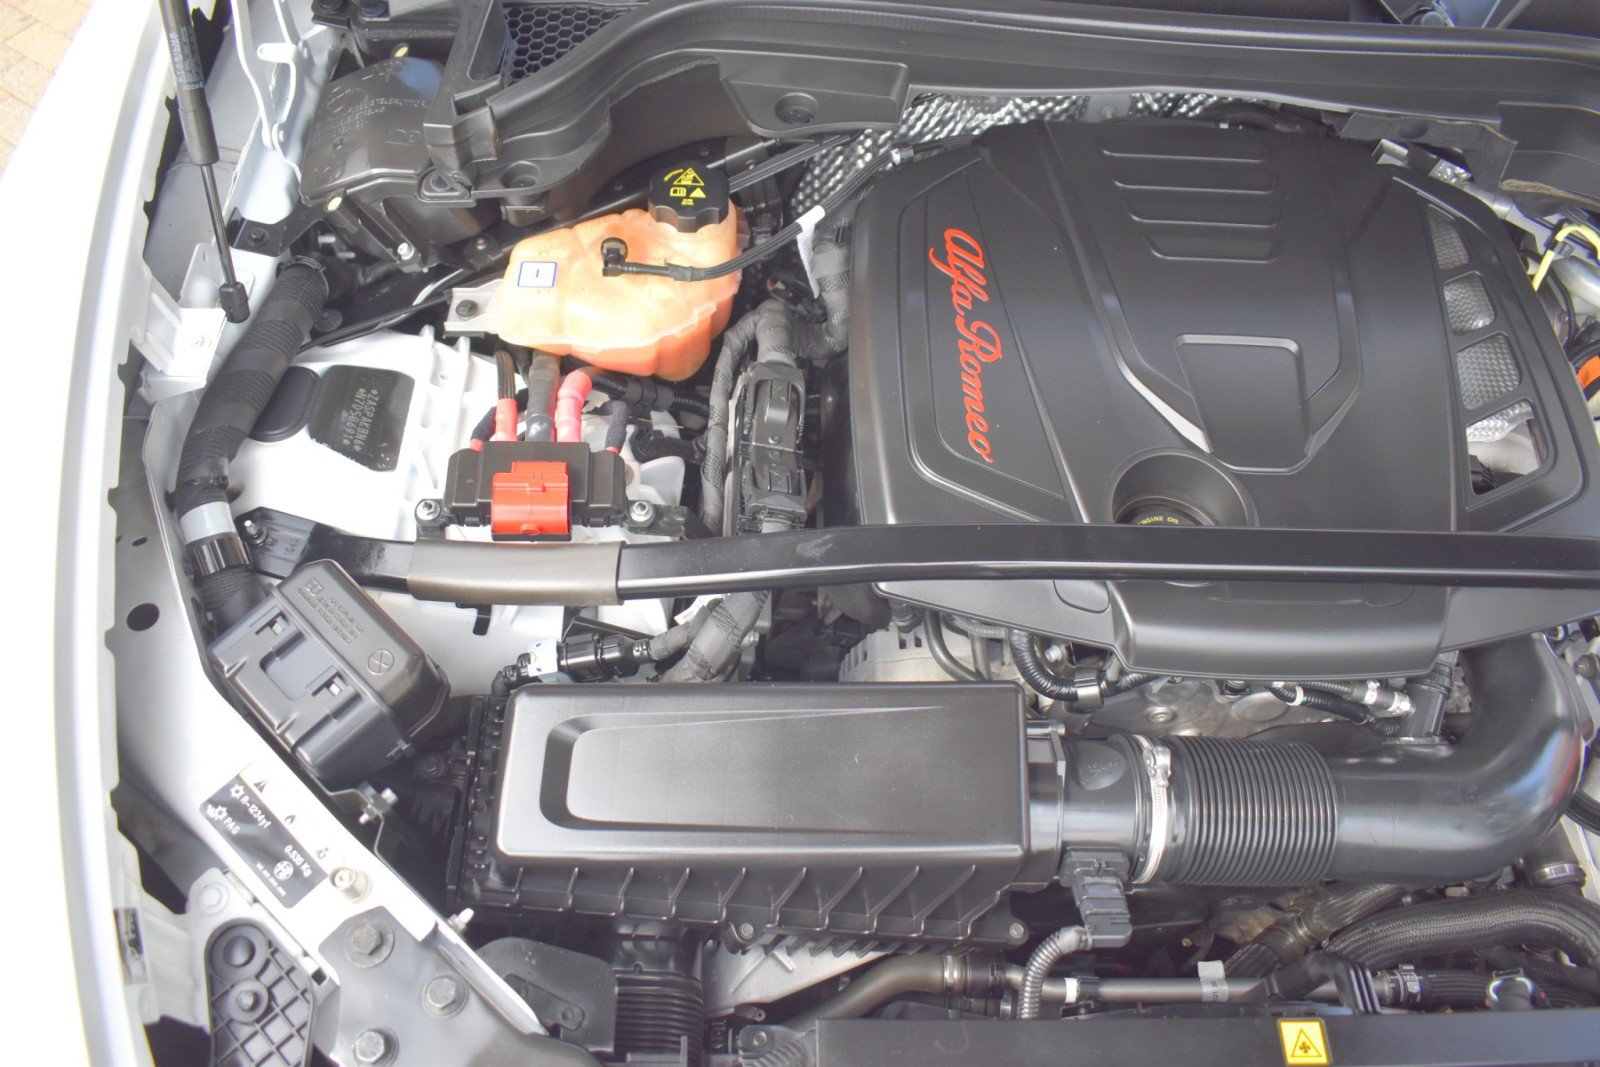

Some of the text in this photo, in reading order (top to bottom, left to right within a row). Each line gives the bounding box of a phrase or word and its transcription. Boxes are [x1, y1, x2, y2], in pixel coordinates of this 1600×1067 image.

[929, 228, 1002, 463] Alfa Romeo
[1138, 516, 1180, 525] NGINE OIL
[223, 817, 240, 835] PAG
